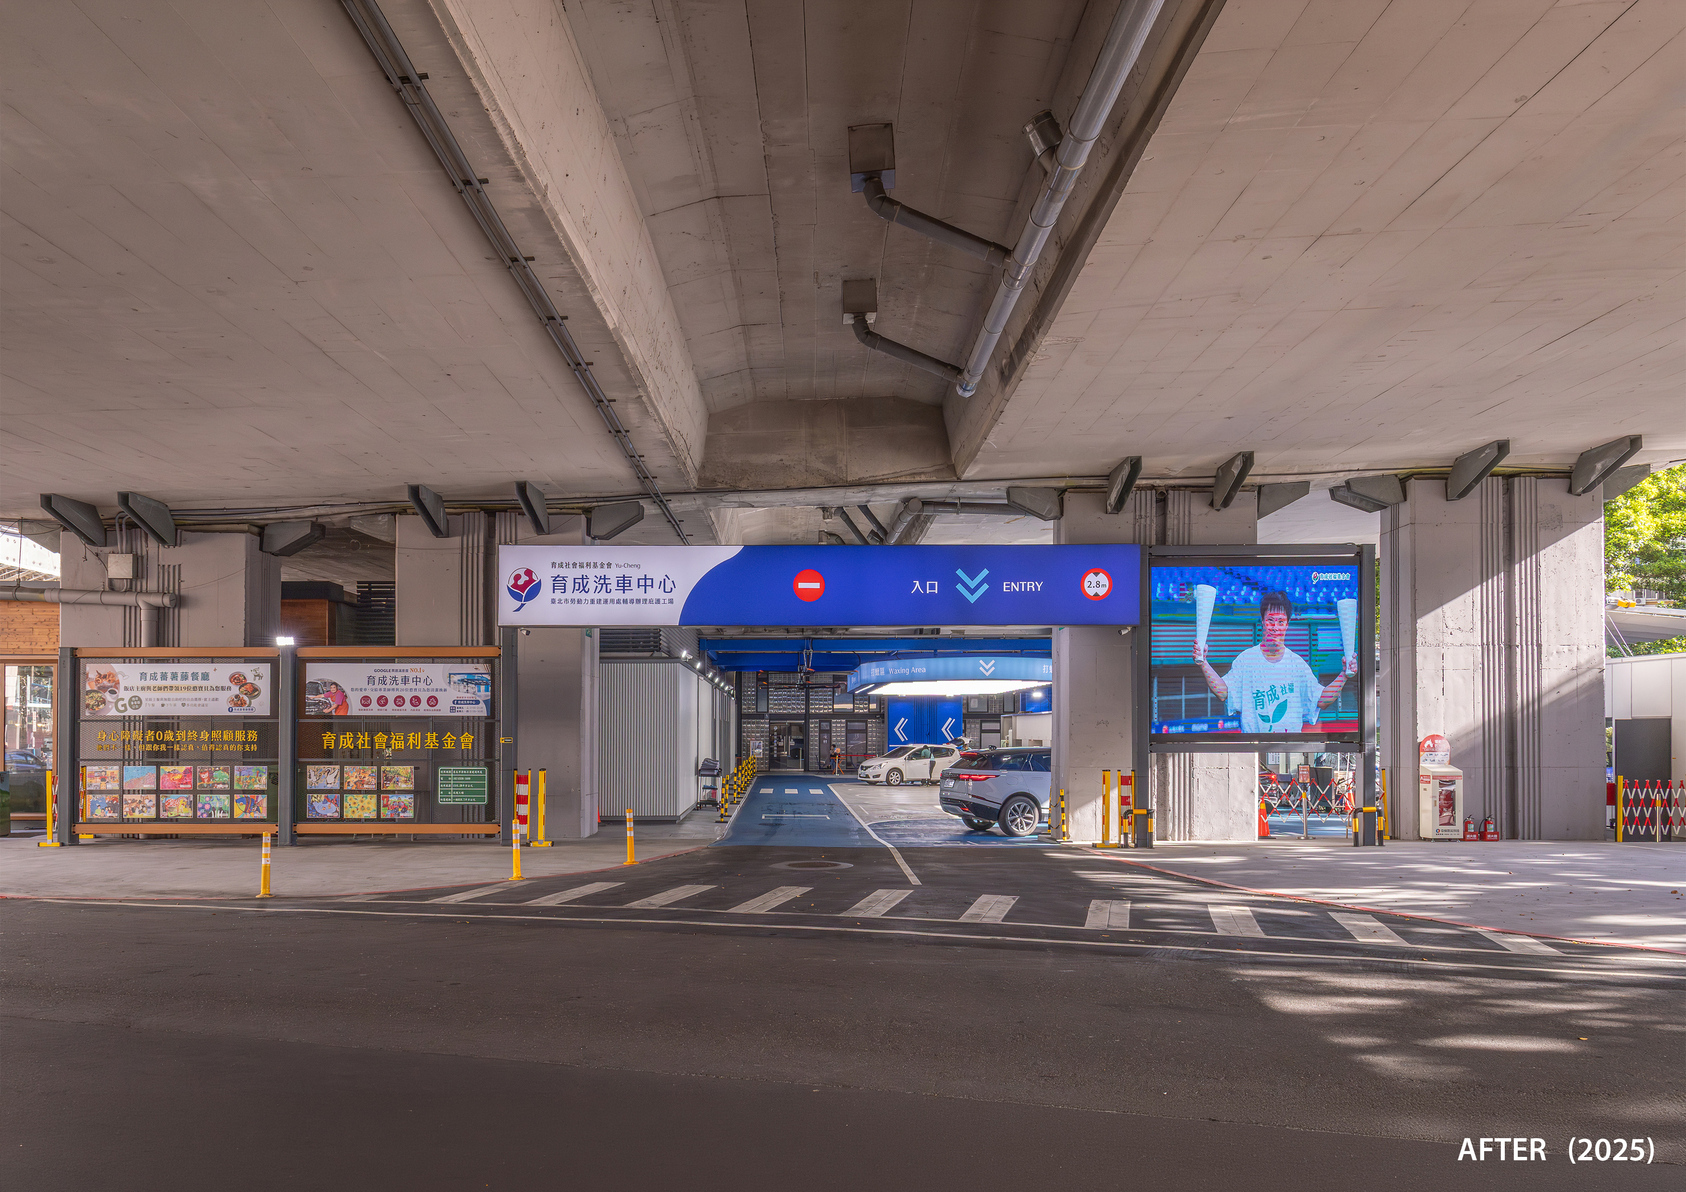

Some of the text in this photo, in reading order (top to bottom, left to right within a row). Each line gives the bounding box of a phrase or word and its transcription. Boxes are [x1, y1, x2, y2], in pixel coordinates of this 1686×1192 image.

[550, 561, 641, 570] 育成社會福利基金會 Yu-Cheng
[550, 574, 677, 595] 育成洗車中心
[911, 580, 939, 594] 入口
[1003, 581, 1044, 592] ENTRY
[888, 667, 910, 676] Waxing
[910, 666, 927, 674] Area
[366, 675, 434, 686] 育成洗車中心
[1252, 684, 1280, 711] 育成
[97, 730, 258, 742] 身心障礙者0歲到終身照顧服務
[321, 731, 475, 750] 育成社會福利基金會
